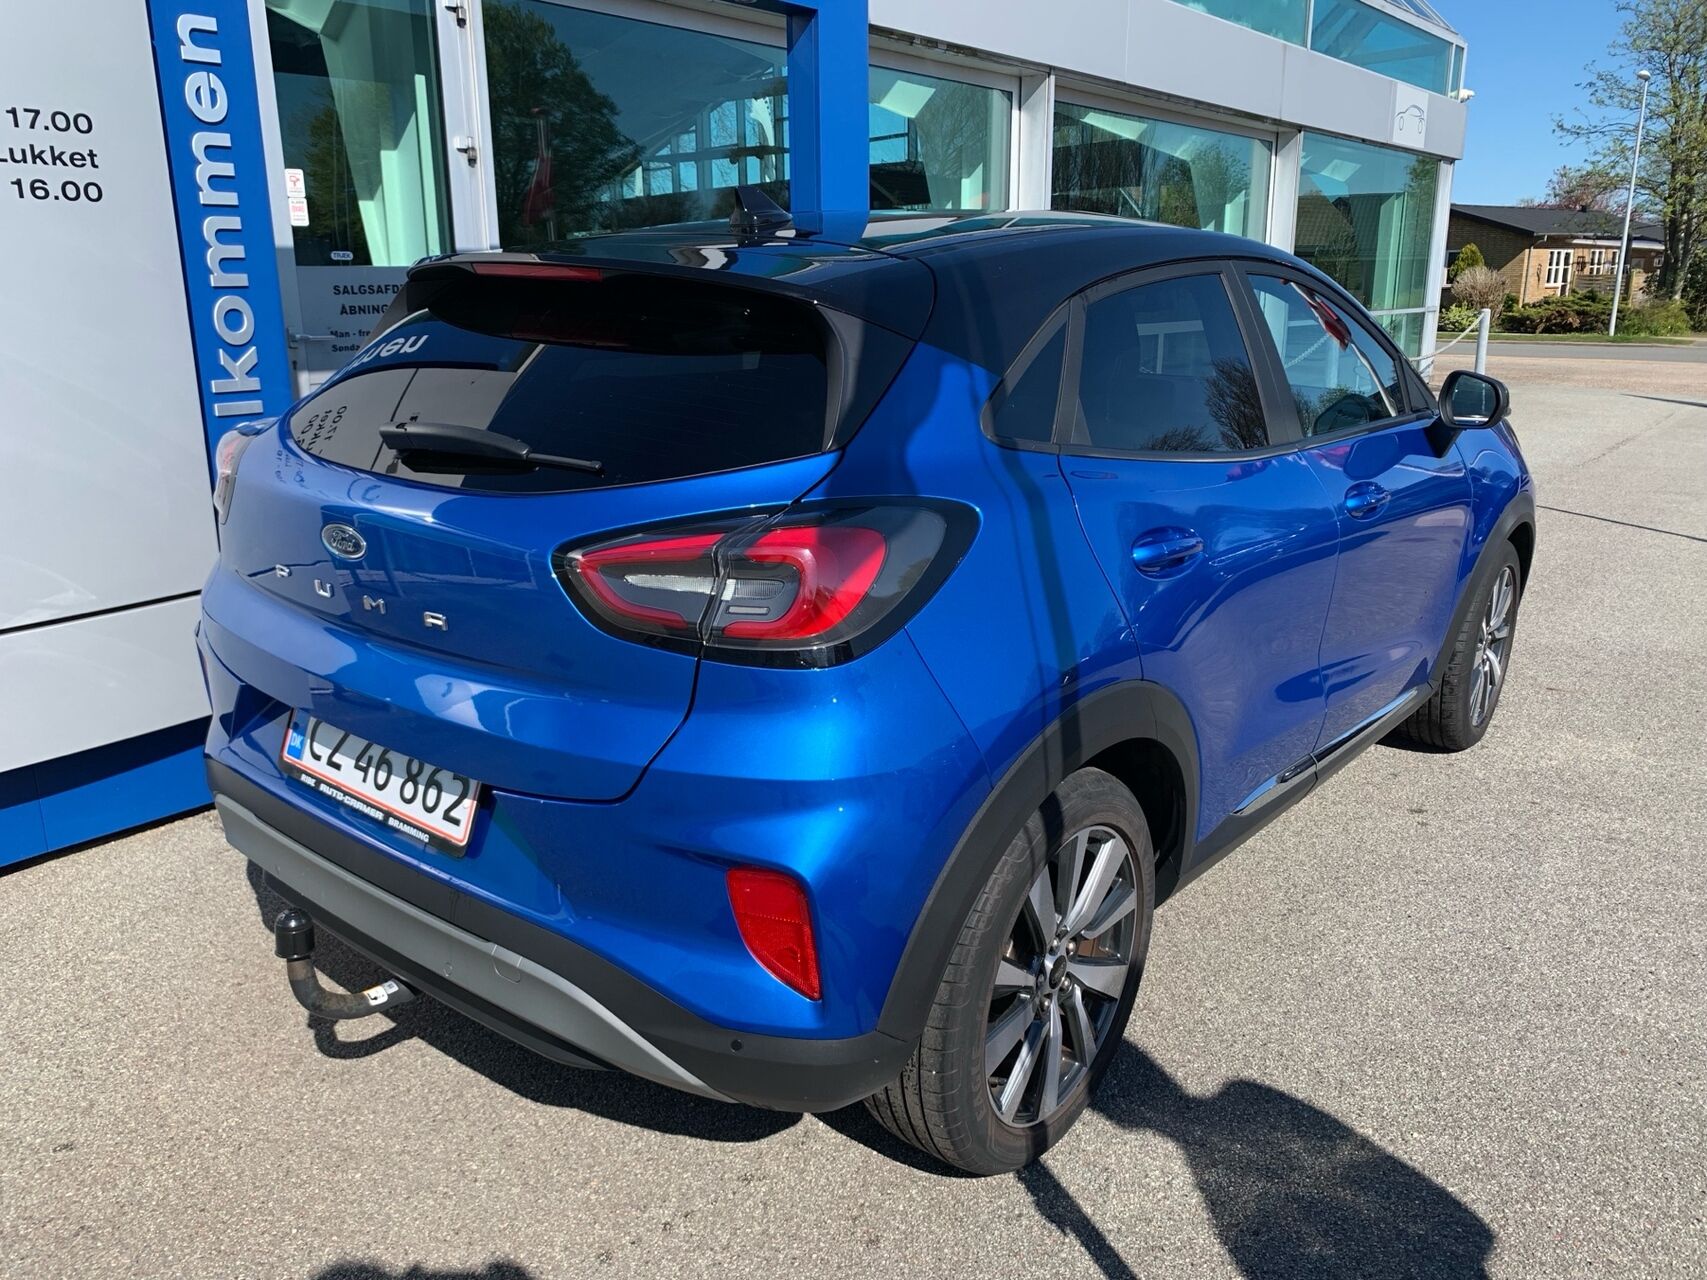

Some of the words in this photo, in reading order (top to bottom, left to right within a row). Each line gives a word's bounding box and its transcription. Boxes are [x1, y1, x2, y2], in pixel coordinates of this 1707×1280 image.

[5, 106, 94, 135] 17.00
[10, 177, 104, 203] 16.00
[333, 284, 403, 295] SALGSAFD
[330, 530, 356, 552] Ford
[275, 564, 449, 631] PUMA
[290, 732, 304, 749] DK
[354, 743, 393, 791] 46
[400, 758, 470, 827] 862
[388, 816, 430, 843] BRAMMING
